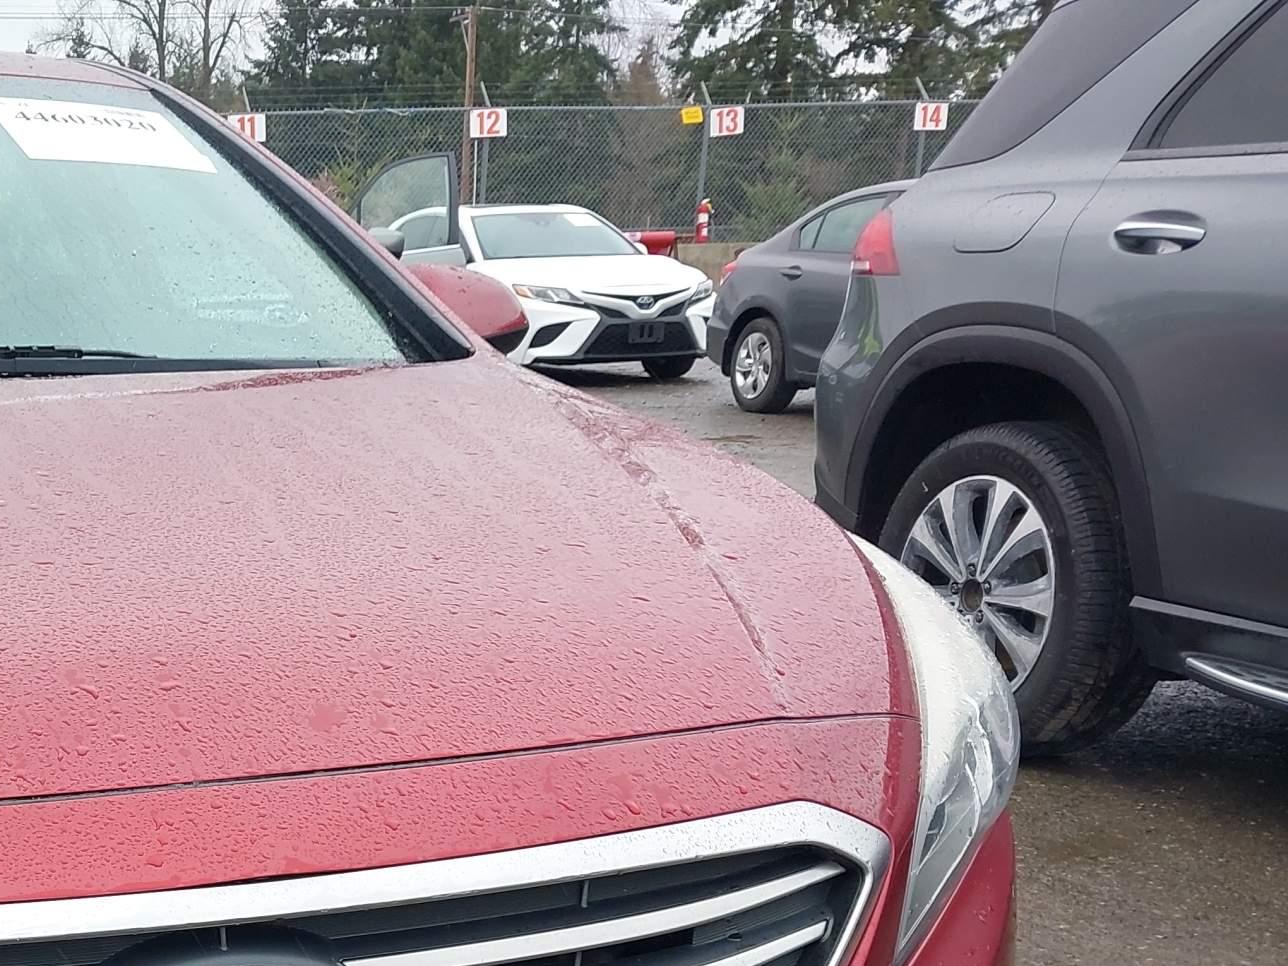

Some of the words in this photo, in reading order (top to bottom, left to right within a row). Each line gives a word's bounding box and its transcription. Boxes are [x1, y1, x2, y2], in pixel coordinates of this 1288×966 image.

[15, 111, 157, 132] 44603020
[237, 116, 256, 139] 11
[477, 110, 501, 135] 12
[716, 108, 738, 134] 13
[921, 104, 942, 128] 14
